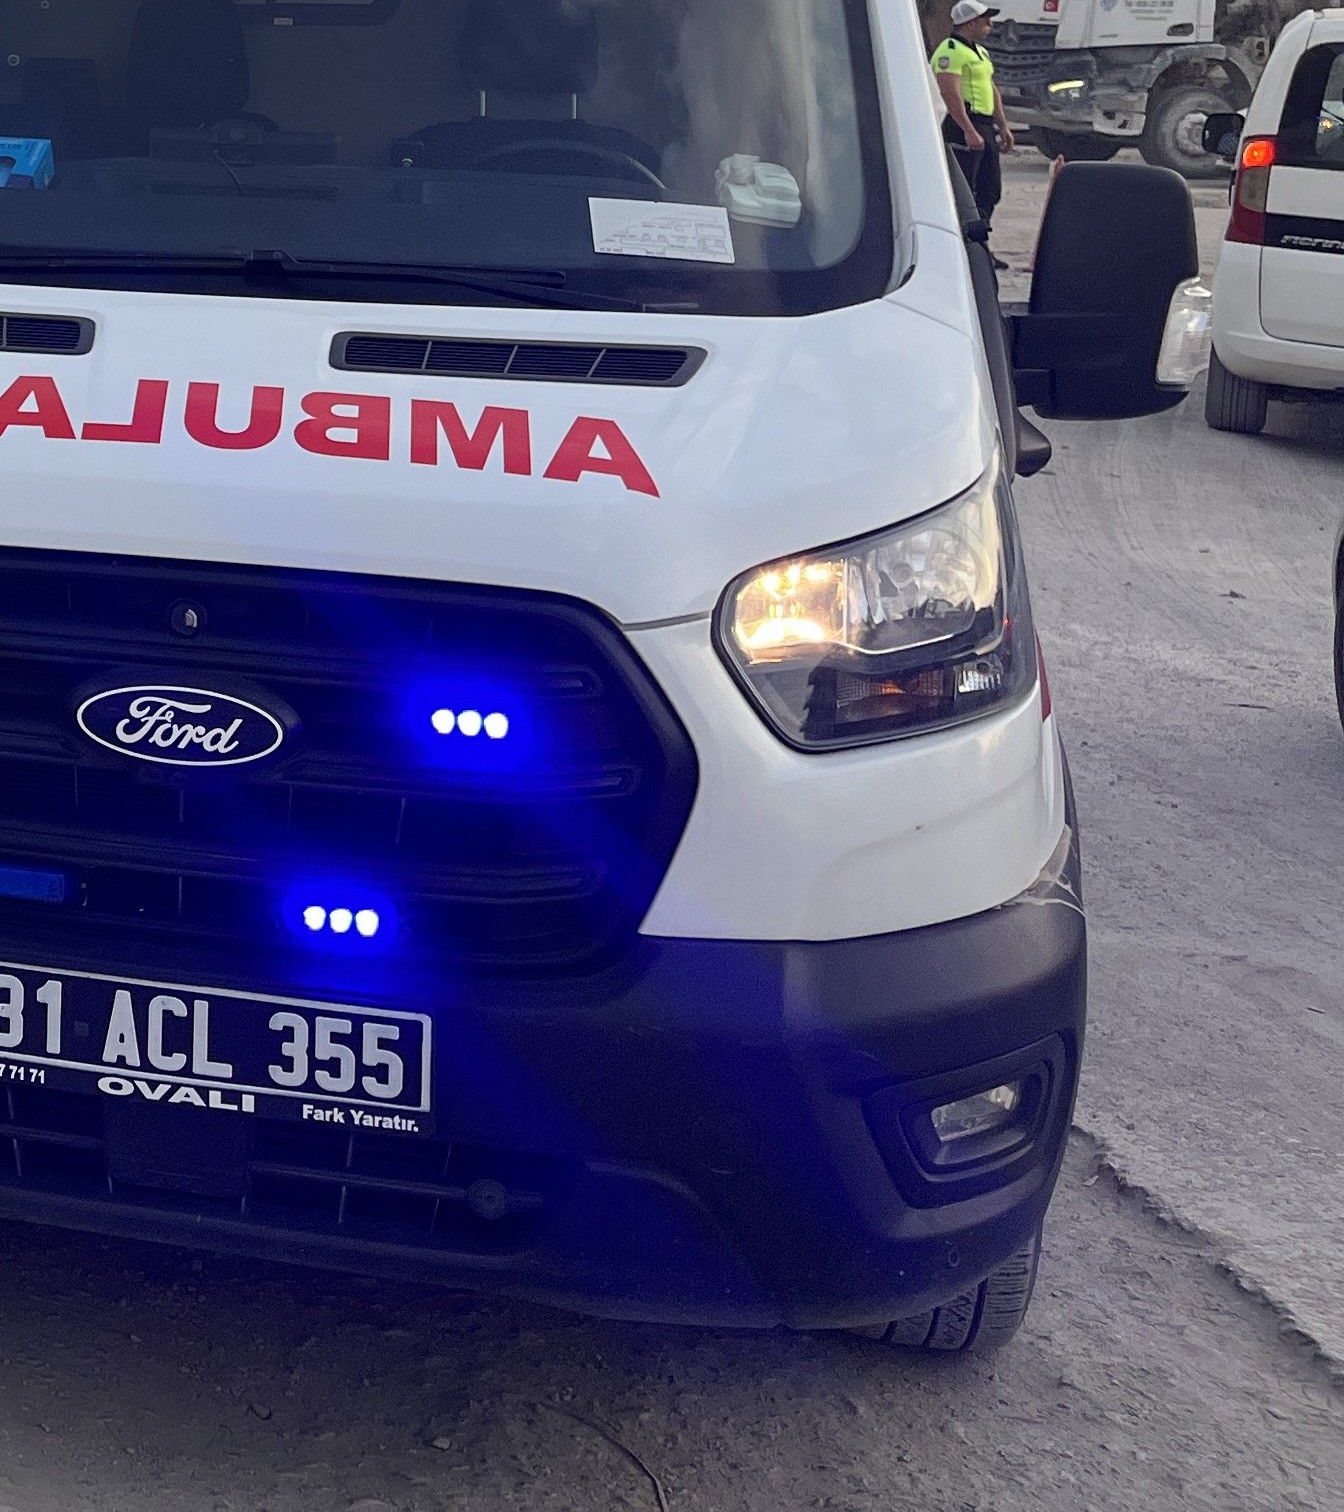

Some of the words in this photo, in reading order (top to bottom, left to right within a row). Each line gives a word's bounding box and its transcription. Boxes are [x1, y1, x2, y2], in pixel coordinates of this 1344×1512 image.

[115, 695, 244, 754] Ford
[102, 989, 233, 1079] ACL
[268, 1011, 404, 1099] 355
[9, 1064, 25, 1081] 71
[29, 1068, 45, 1084] 71
[97, 1076, 255, 1113] OVALI
[302, 1103, 346, 1125] Fark
[349, 1109, 419, 1133] Yaratır.
